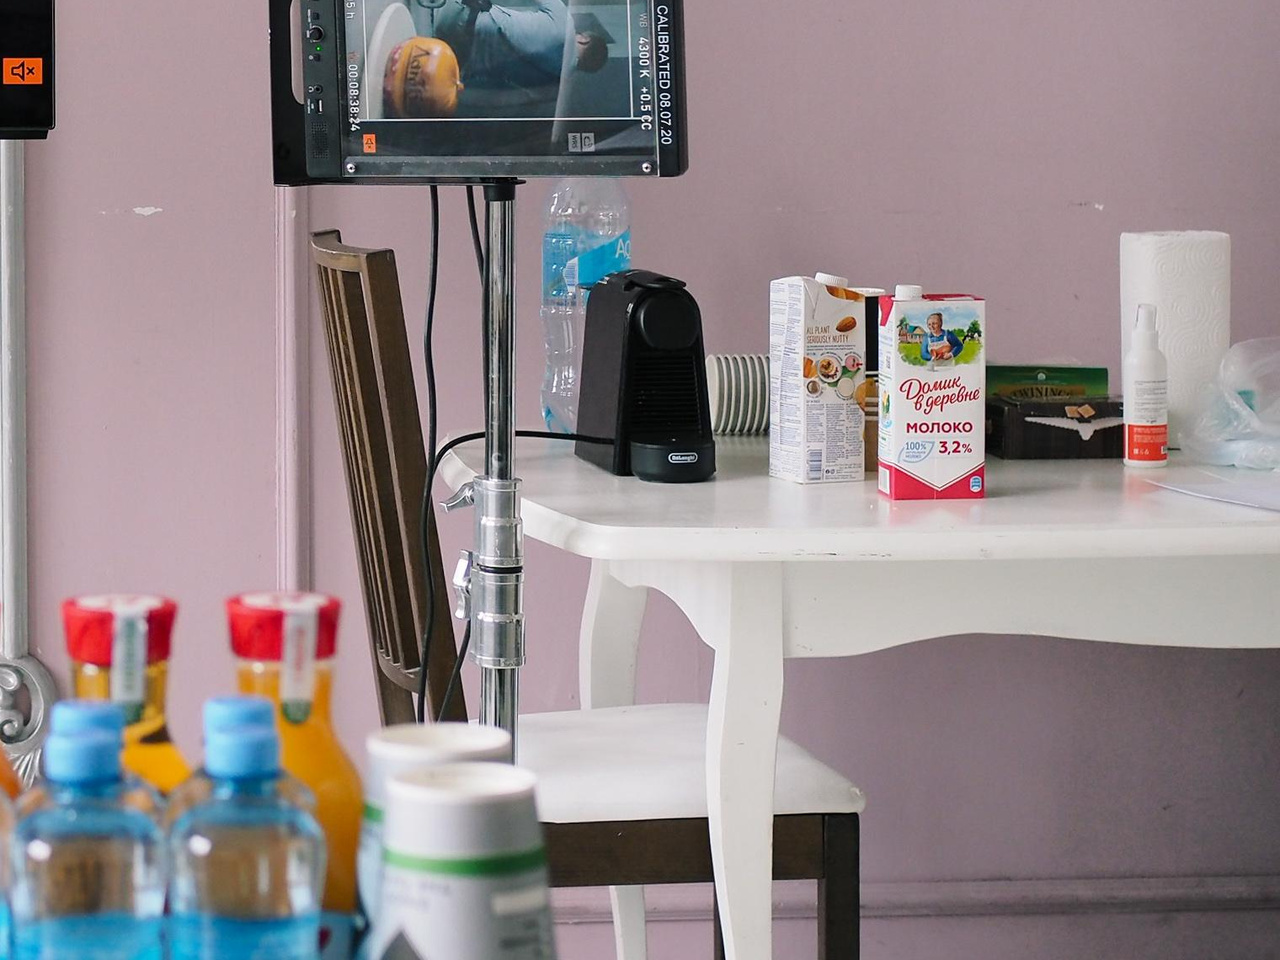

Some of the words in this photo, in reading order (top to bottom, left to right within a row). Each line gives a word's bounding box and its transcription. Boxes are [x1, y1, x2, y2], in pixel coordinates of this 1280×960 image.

[639, 37, 649, 66] 4300
[656, 5, 670, 89] CALIBRATED
[348, 64, 360, 131] 00:08:38:24
[640, 87, 650, 111] +0.5
[660, 93, 672, 144] 08.07.20
[900, 376, 962, 401] Домик
[923, 385, 980, 415] деревне
[906, 421, 973, 434] МОЛОКО
[905, 441, 927, 451] 100%
[939, 441, 973, 455] 3,2%
